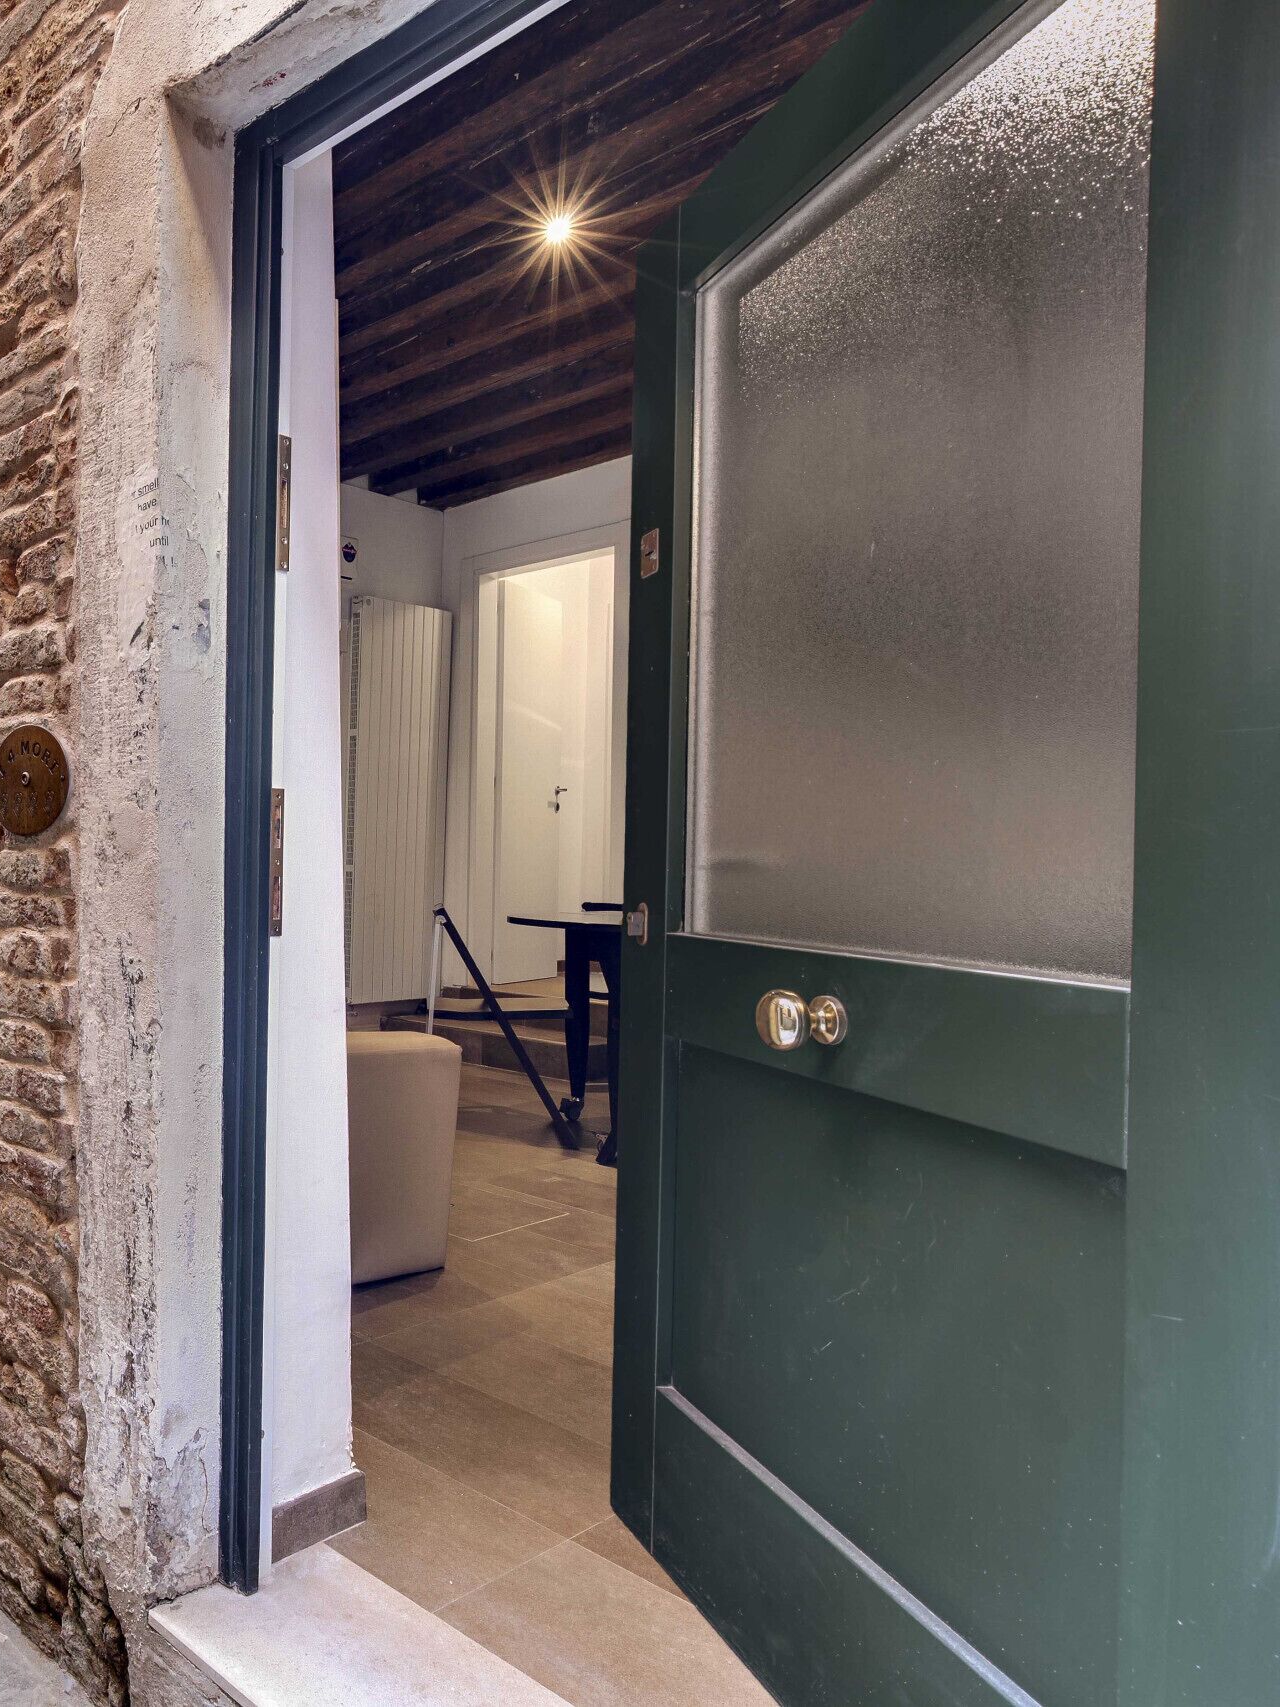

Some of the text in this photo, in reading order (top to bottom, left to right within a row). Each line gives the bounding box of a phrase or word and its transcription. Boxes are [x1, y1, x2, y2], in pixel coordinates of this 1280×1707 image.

[137, 477, 159, 496] smell
[137, 498, 157, 512] have
[139, 517, 159, 535] your
[149, 535, 169, 548] until
